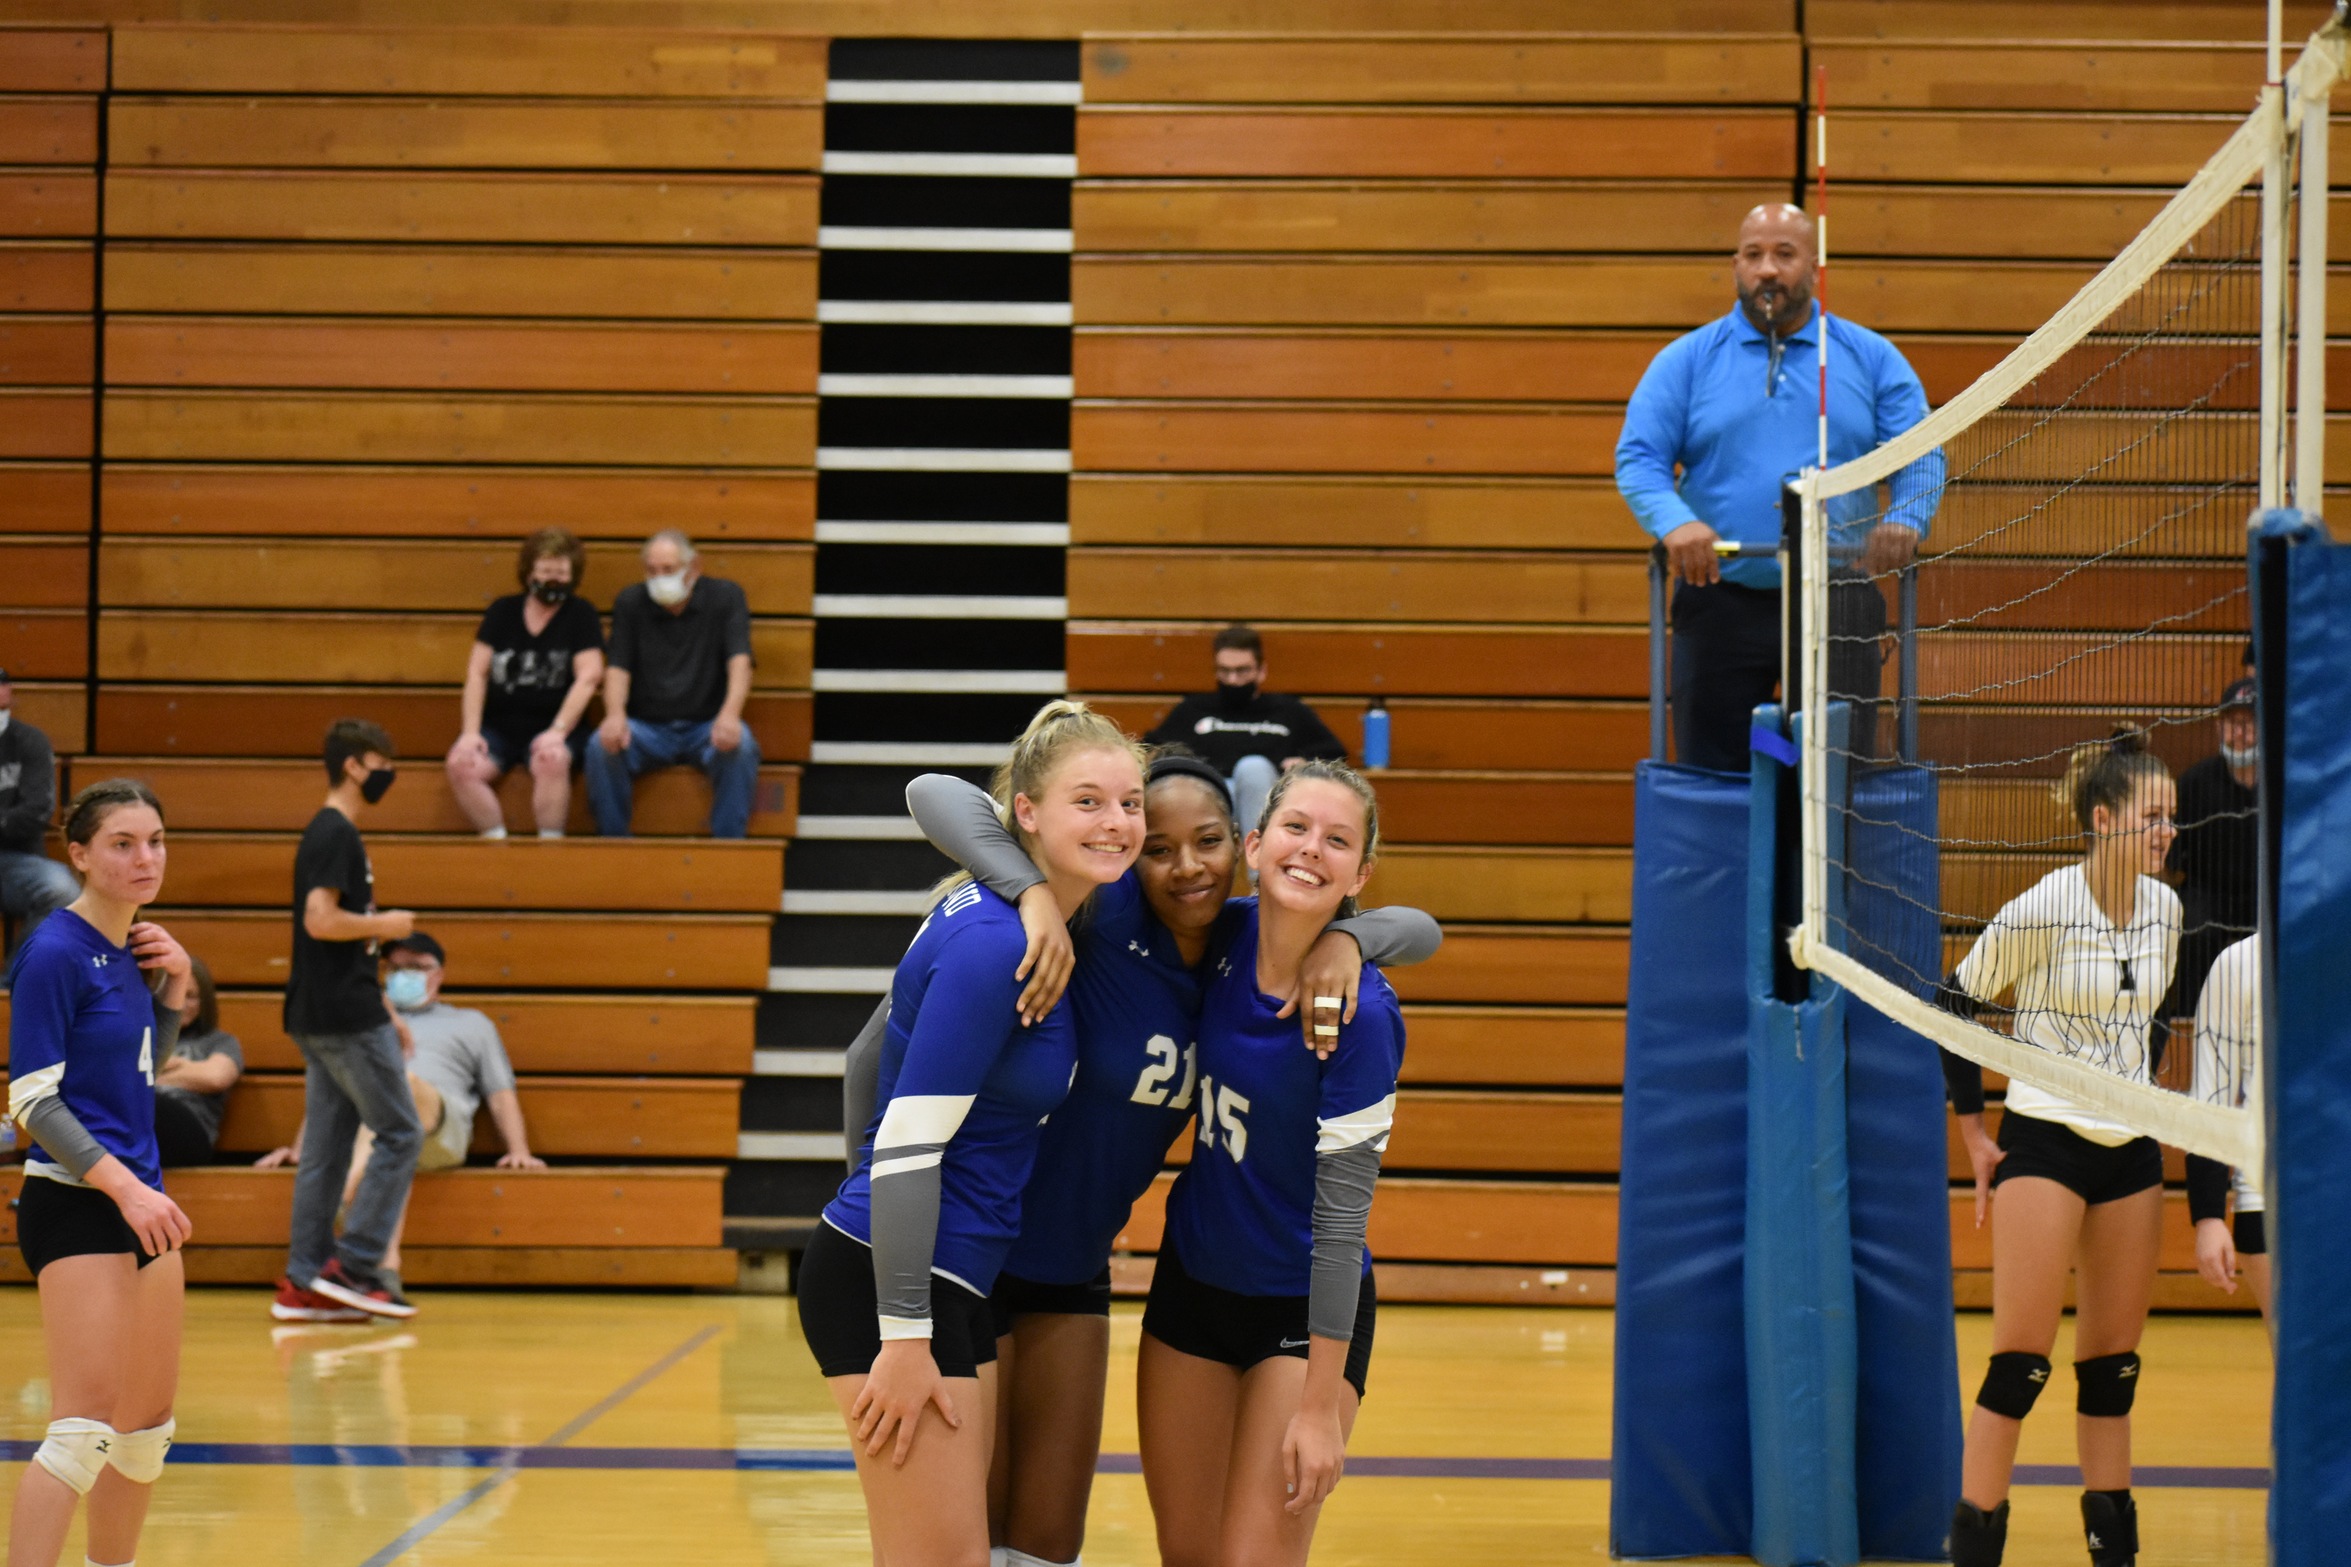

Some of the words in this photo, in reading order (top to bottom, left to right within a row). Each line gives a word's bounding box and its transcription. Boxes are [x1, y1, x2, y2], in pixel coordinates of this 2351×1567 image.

[138, 1026, 154, 1087] 4
[1129, 1033, 1196, 1110] 21
[1199, 1074, 1250, 1164] 15
